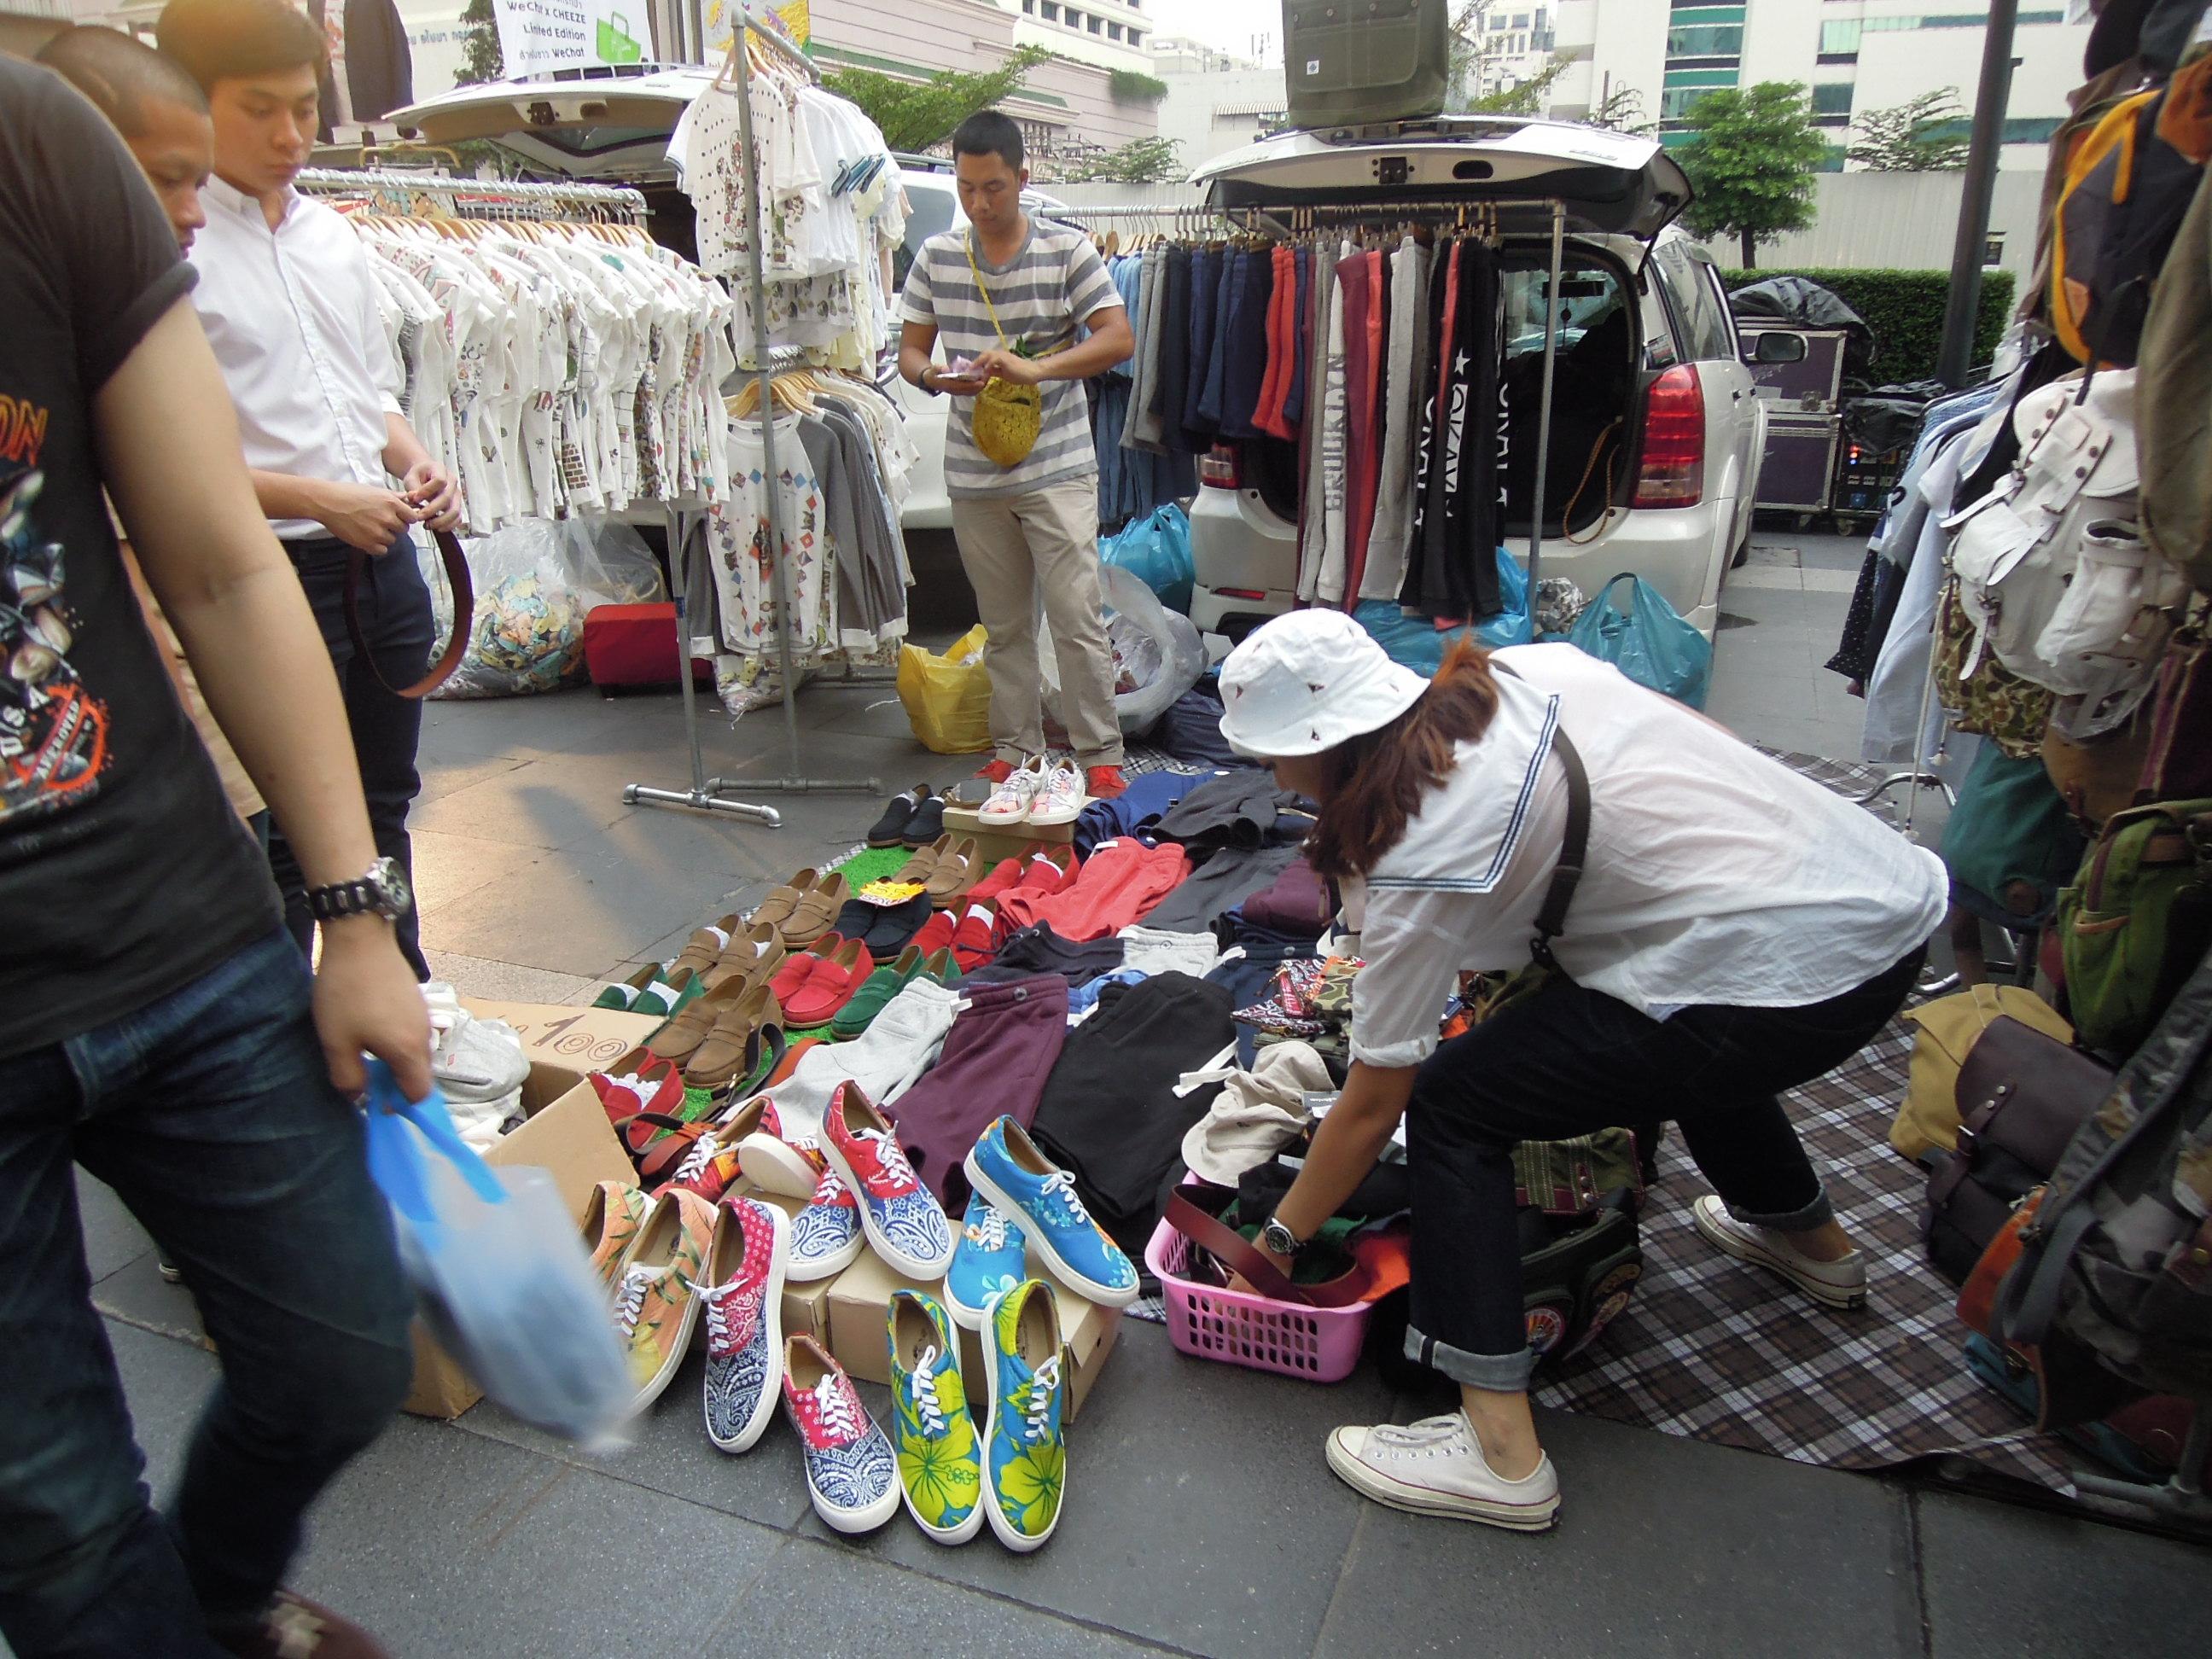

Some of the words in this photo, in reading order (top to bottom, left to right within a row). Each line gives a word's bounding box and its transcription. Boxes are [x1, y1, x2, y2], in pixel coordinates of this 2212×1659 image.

[553, 9, 586, 24] CHEEZE
[523, 22, 552, 37] Lited
[555, 28, 586, 41] Edition
[551, 47, 585, 59] WeChat
[533, 1014, 628, 1062] 100
